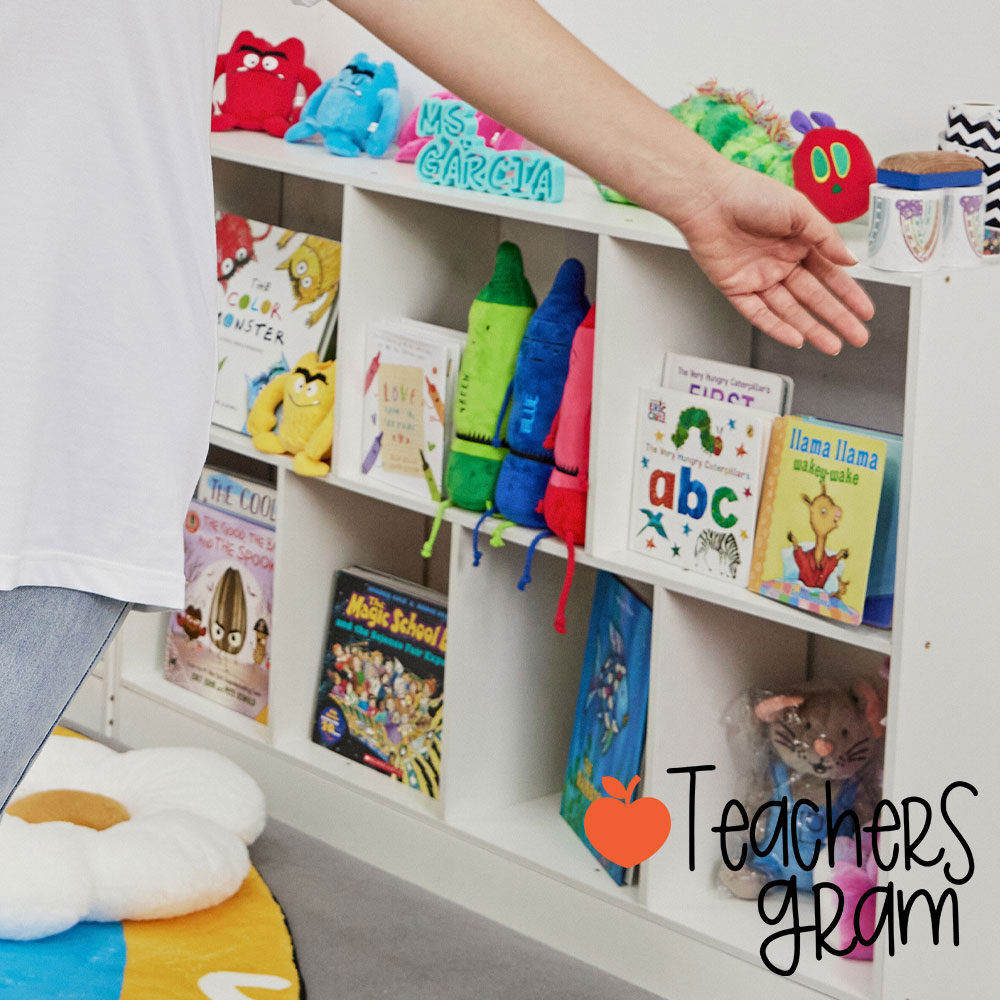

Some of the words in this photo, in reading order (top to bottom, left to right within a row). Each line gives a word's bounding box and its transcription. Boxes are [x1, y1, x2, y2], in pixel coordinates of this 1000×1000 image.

[251, 277, 271, 292] THE
[226, 292, 282, 320] COLOR
[789, 427, 831, 458] llama
[835, 438, 879, 470] llama
[210, 477, 233, 506] THE
[649, 466, 738, 529] abc
[345, 592, 391, 629] Magic
[390, 607, 442, 647] School
